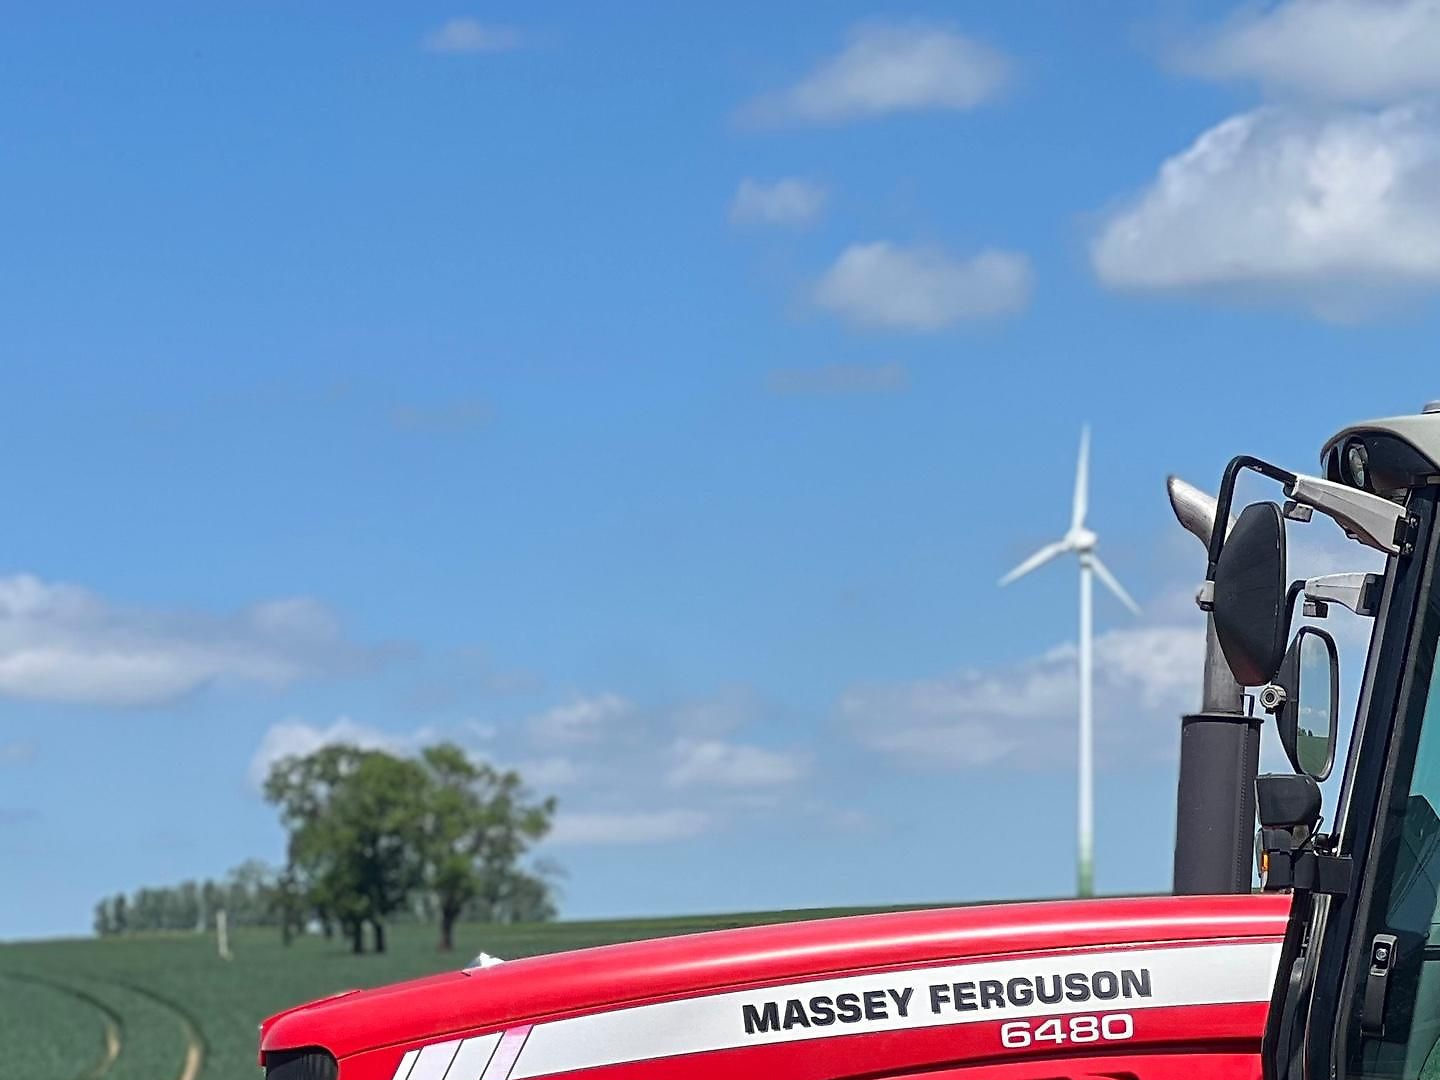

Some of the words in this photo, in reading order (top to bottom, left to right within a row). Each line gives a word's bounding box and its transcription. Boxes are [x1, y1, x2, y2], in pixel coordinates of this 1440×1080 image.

[742, 986, 914, 1035] MASSEY
[928, 968, 1153, 1015] FERGUSON
[1000, 1013, 1135, 1049] 6480
